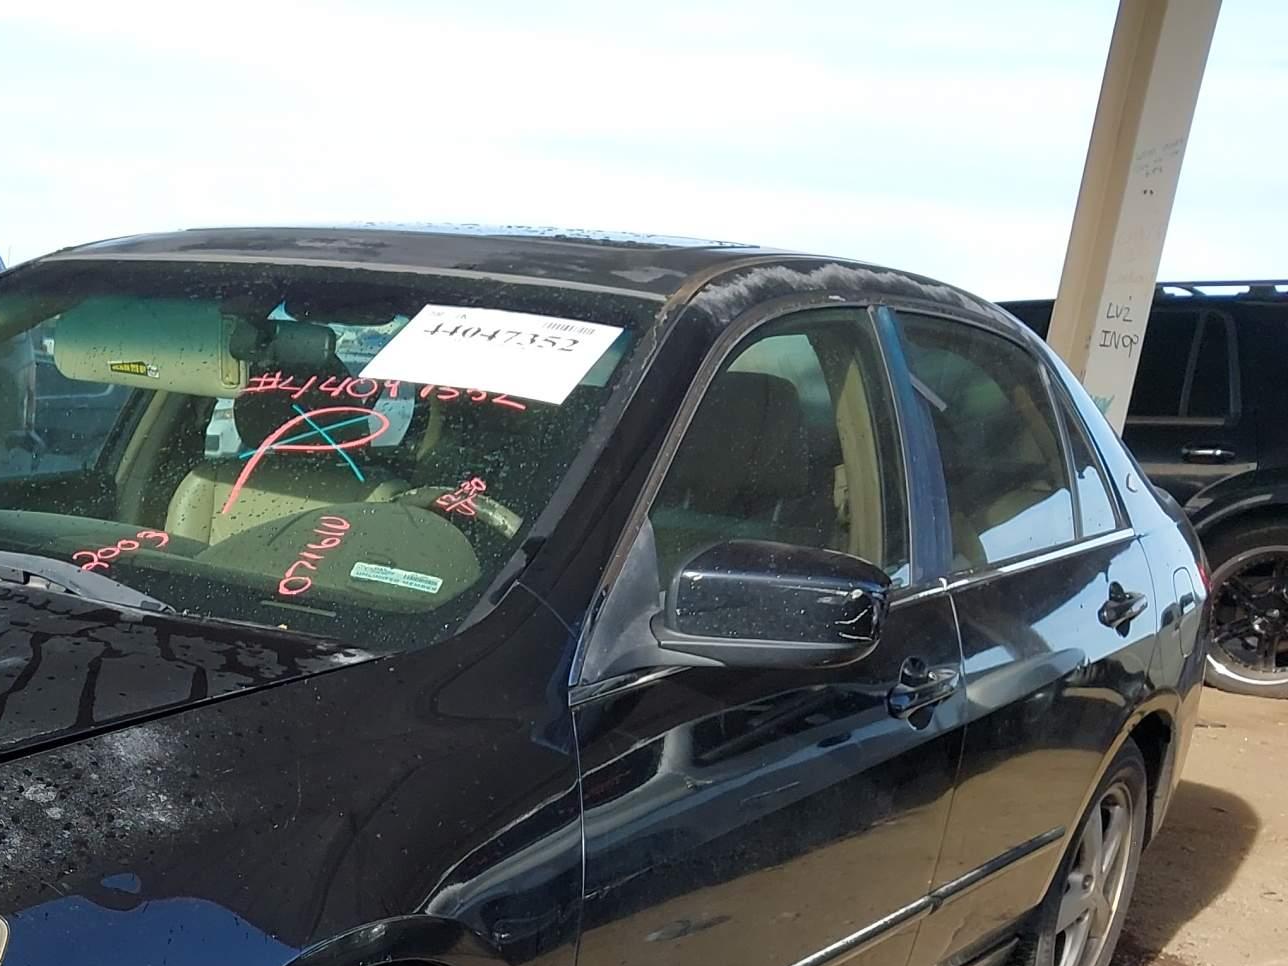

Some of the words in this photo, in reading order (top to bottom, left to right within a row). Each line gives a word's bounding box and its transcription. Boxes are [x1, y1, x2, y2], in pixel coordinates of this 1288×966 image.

[424, 322, 580, 352] 44047352
[1099, 330, 1139, 358] INOP
[72, 531, 170, 571] 2003
